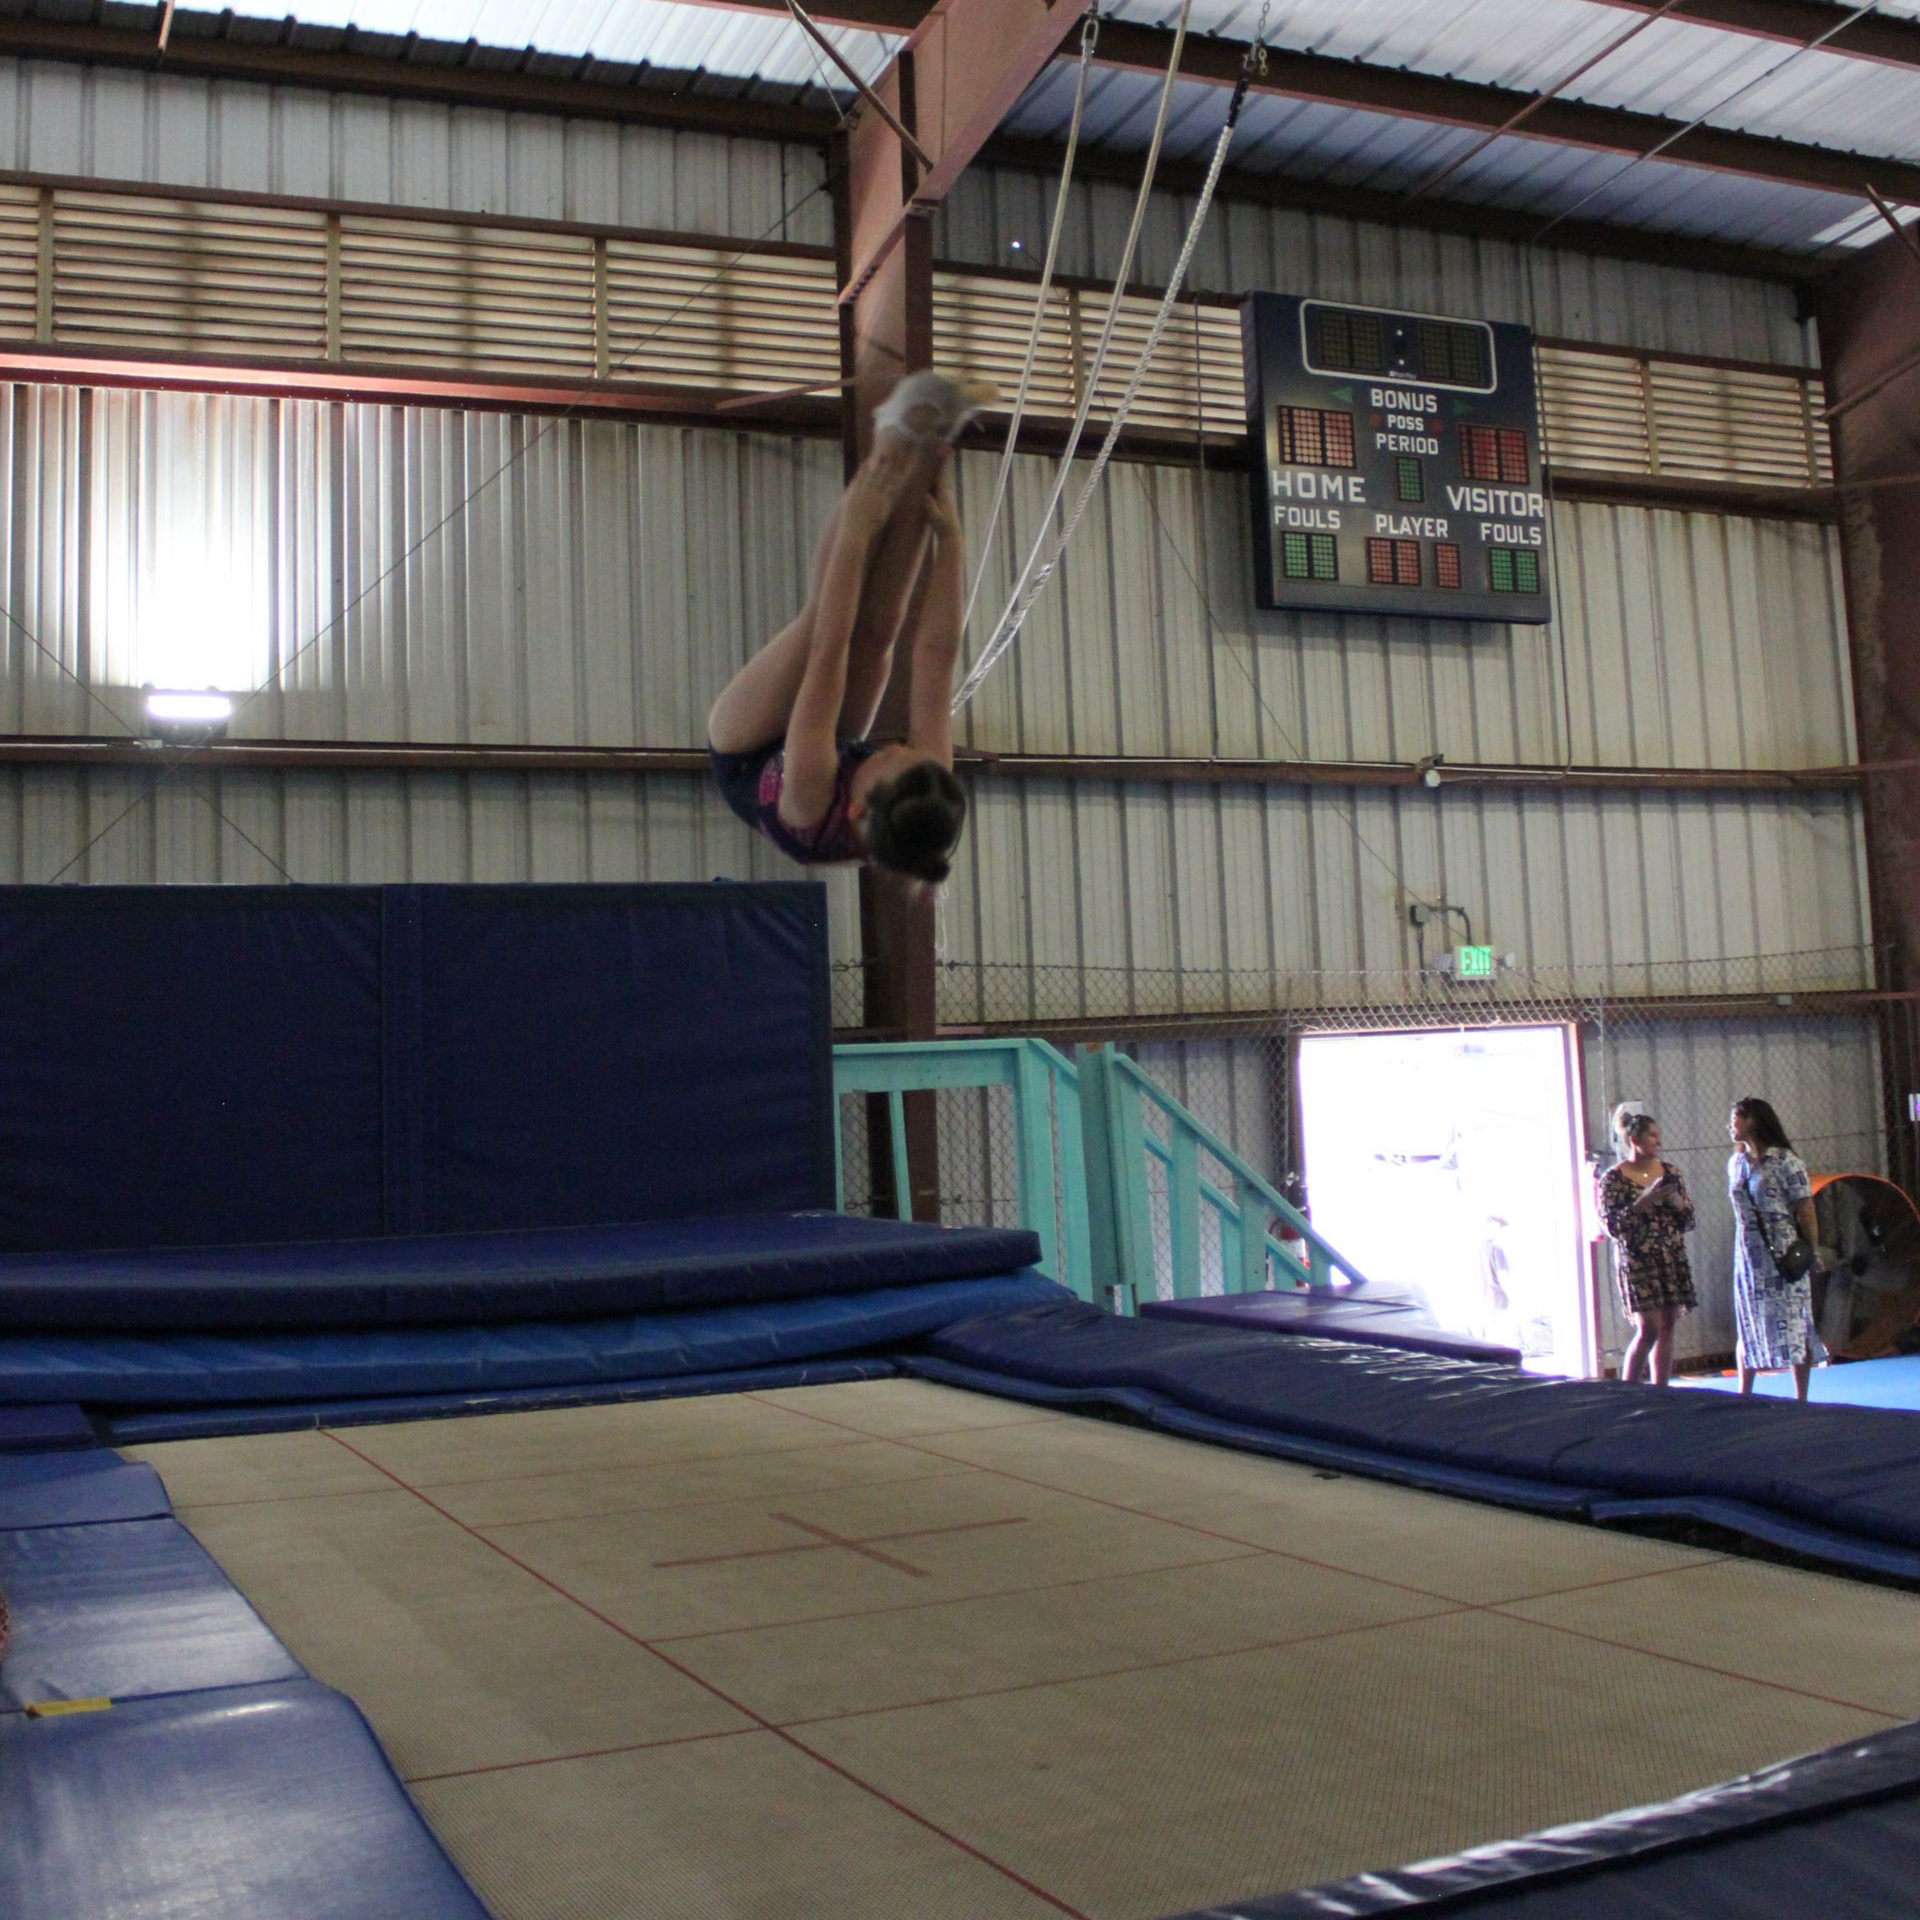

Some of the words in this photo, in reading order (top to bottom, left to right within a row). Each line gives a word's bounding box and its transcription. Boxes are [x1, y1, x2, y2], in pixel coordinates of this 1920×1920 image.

[1371, 388, 1438, 413] BONUS
[1387, 414, 1424, 431] POSS
[1376, 433, 1439, 455] PERIOD
[1271, 470, 1366, 503] HOME
[1446, 485, 1544, 518] VISITOR
[1274, 506, 1341, 530] FOULS
[1375, 513, 1448, 538] PLAYER
[1480, 523, 1542, 546] FOULS
[1460, 947, 1492, 976] EXIT
